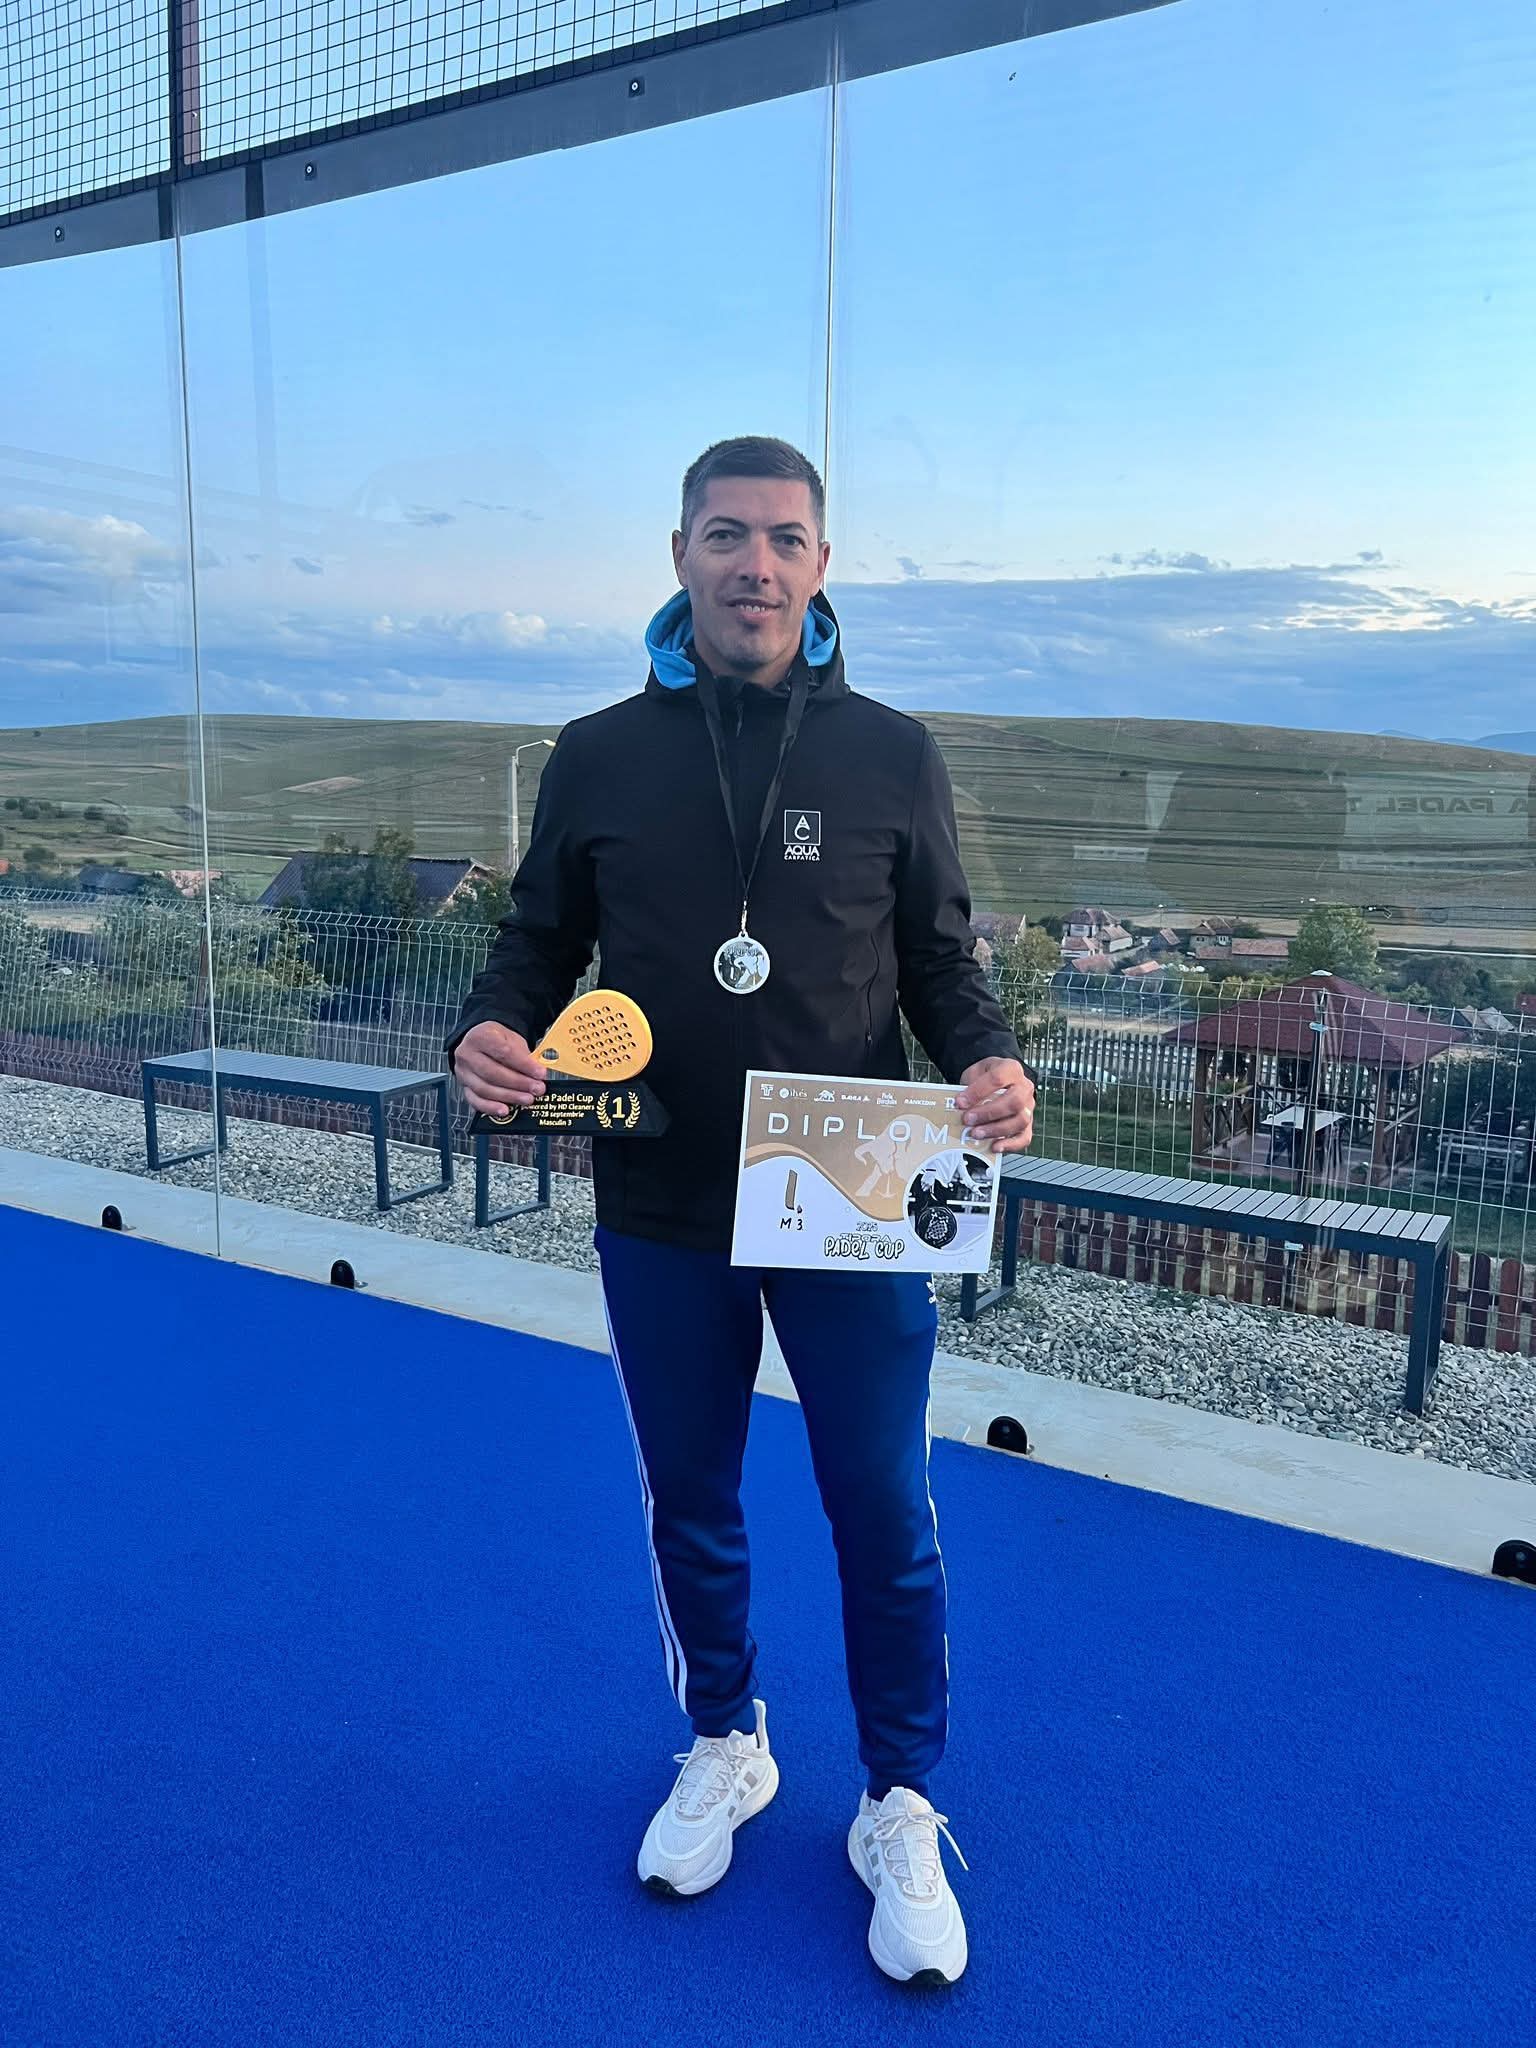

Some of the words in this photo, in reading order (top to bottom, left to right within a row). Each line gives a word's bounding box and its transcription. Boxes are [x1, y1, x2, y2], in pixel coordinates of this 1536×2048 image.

[784, 845, 820, 856] AQUA
[551, 1093, 575, 1102] Padel
[576, 1093, 594, 1104] Cup
[549, 1103, 557, 1111] by
[612, 1096, 626, 1119] 1
[780, 1217, 792, 1229] M
[796, 1218, 803, 1231] 3
[824, 1236, 870, 1260] PADEL
[875, 1238, 905, 1260] CUP
